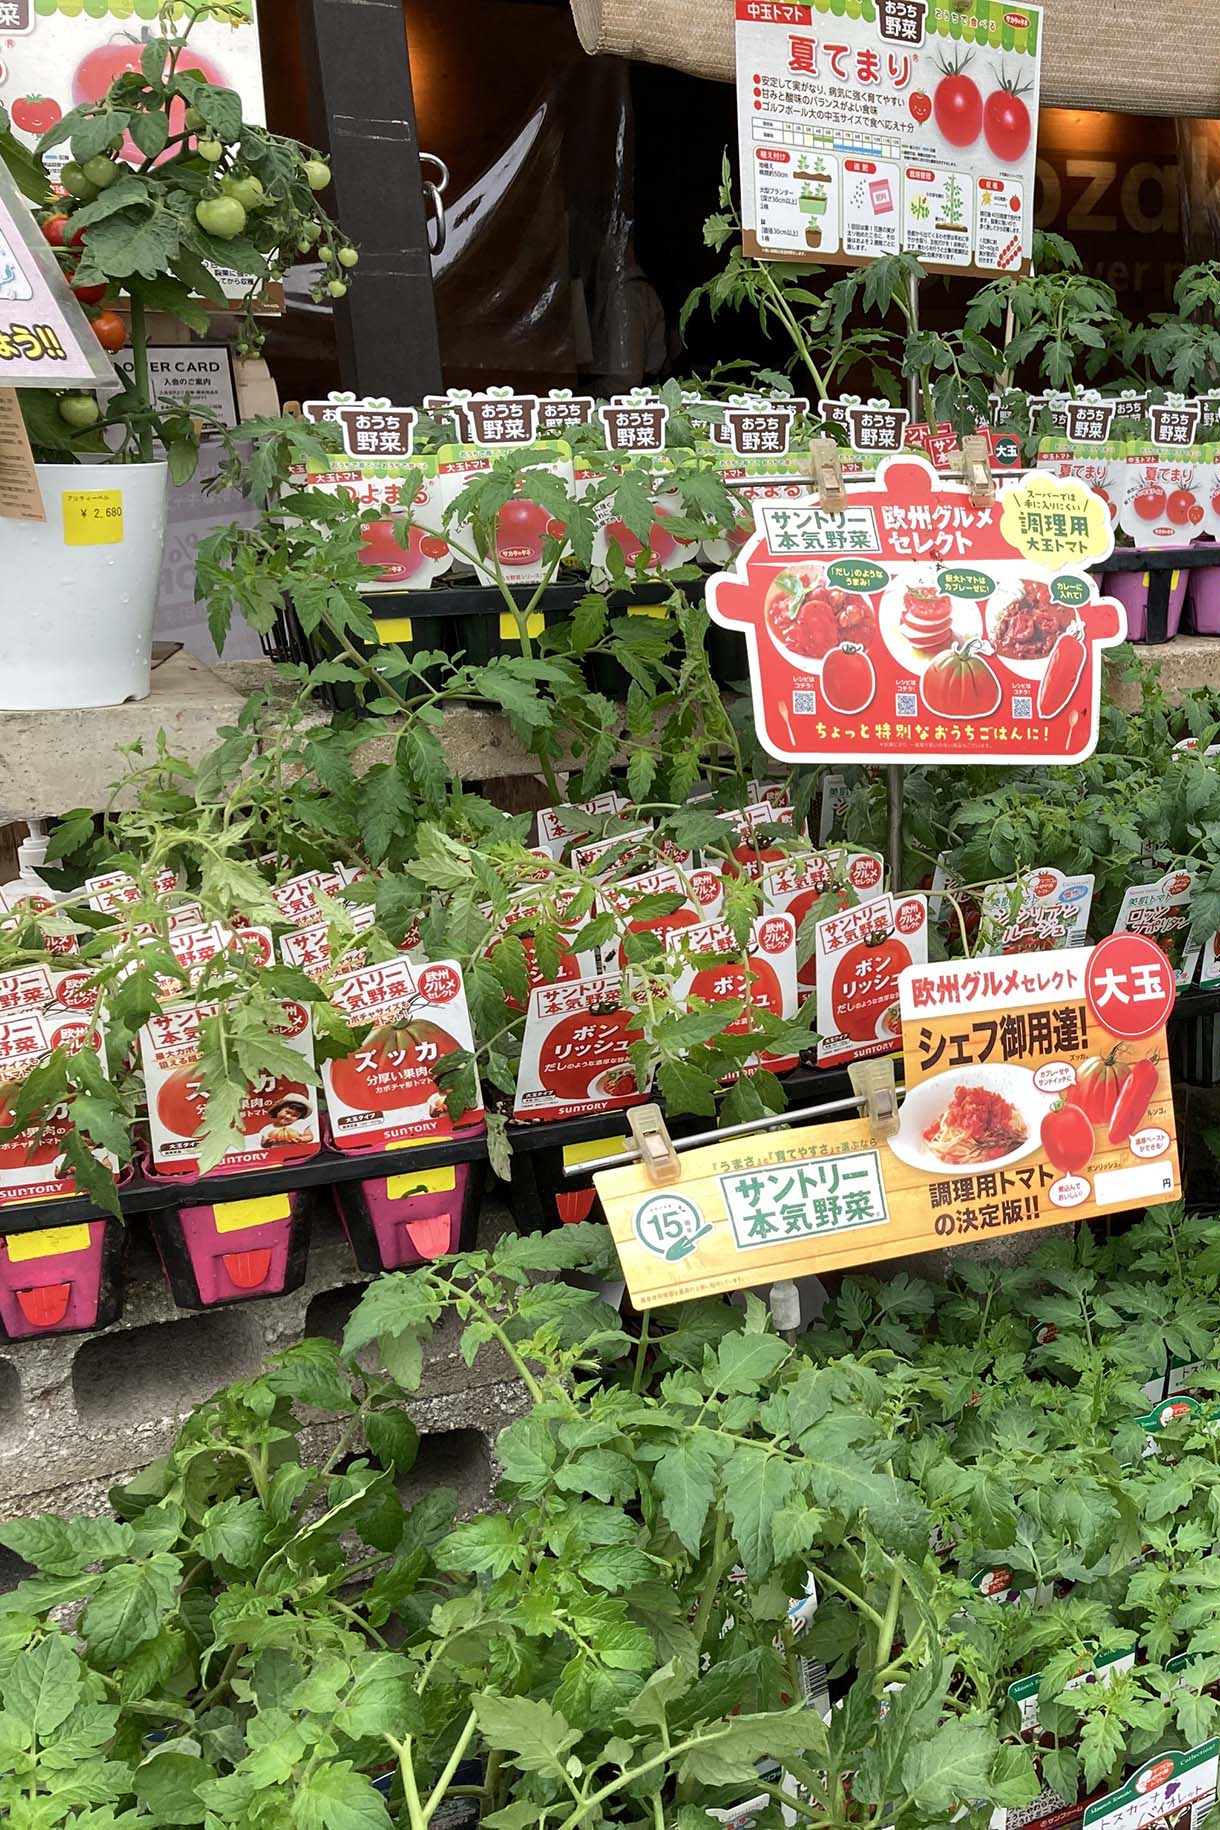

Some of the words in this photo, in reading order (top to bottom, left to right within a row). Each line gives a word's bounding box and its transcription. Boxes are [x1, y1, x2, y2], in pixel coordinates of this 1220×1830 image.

[747, 2, 803, 22] 中玉トマト
[885, 1, 918, 18] おうち
[885, 16, 918, 40] 野菜
[761, 75, 905, 107] 安定して実がなり、病気に強く育てやすい
[762, 89, 877, 115] 甘みと酸味のバランスがよい食味
[762, 102, 914, 133] ゴルフボール大の中玉サイズで食べ応え十分
[175, 362, 220, 372] CARD
[164, 378, 211, 386] 入会のご案内
[481, 403, 523, 417] おうち
[544, 403, 581, 417] おうち
[1077, 409, 1104, 421] おうち
[356, 415, 400, 430] おうち
[616, 413, 654, 425] おうち
[741, 418, 779, 430] おうち
[861, 414, 896, 427] おうち
[1160, 412, 1189, 425] おうち
[483, 419, 529, 440] 野菜
[617, 427, 659, 447] 野菜
[1075, 422, 1104, 439] 野菜
[1159, 426, 1190, 442] 野菜
[356, 431, 402, 452] 野菜
[742, 432, 783, 451] 野菜
[861, 429, 898, 448] 野菜
[996, 445, 1018, 457] 大玉
[445, 461, 488, 473] 大玉トマト
[1060, 464, 1105, 480] 夏てまり
[1145, 466, 1193, 482] 夏てまり
[316, 473, 358, 482] 大玉トマト
[1026, 490, 1076, 502] スーパーでは
[80, 508, 87, 518] ¥
[94, 506, 122, 519] 2,680
[1024, 499, 1081, 512] 手に入りにくい
[771, 509, 867, 529] サントリー
[882, 506, 993, 529] 欧州グルメ
[1019, 513, 1090, 538] 調理用
[776, 530, 872, 550] 本気野菜
[887, 534, 972, 556] セレクト
[1026, 539, 1089, 554] 大玉トマト
[830, 566, 883, 579] 「だし」のような
[944, 574, 987, 584] 巨大トマトは
[845, 577, 871, 588] うまみ!
[944, 582, 990, 593] カプレーゼに!
[1056, 582, 1083, 592] カレーに
[1060, 590, 1082, 600] 入れて!
[815, 722, 1049, 741] ちょっと特別なおうちごはんに!
[854, 868, 881, 880] グルメ
[856, 861, 874, 871] 欧州
[854, 876, 877, 885] セレクト
[900, 904, 919, 917] 欧州
[824, 903, 888, 936] サントリー
[898, 912, 922, 926] グルメ
[765, 922, 785, 934] 欧州
[900, 922, 921, 934] セレクト
[763, 931, 790, 944] グルメ
[765, 941, 788, 951] セレクト
[855, 957, 891, 977] ボン
[424, 969, 449, 983] 欧州
[423, 977, 459, 995] グルメ
[544, 981, 619, 1001] サントリー
[912, 969, 1077, 1008] 欧州グルメセレクト
[1095, 964, 1165, 1008] 大玉
[427, 989, 457, 1001] セレクト
[574, 1024, 619, 1041] ボン
[918, 1006, 1088, 1070] シェフ御用達!
[354, 1042, 437, 1071] ズッカ
[555, 1039, 629, 1059] リッシュ
[854, 1041, 893, 1058] SUNTORY
[558, 1102, 608, 1115] SUNTORY
[384, 1122, 437, 1138] SUNTORY
[735, 1165, 869, 1207] サントリー
[929, 1164, 1054, 1208] 調理用トマト
[1163, 1178, 1171, 1189] 円
[743, 1191, 874, 1239] 本気野菜
[935, 1196, 1040, 1236] の決定版!!
[648, 1211, 683, 1240] 15
[1101, 1793, 1160, 1830] トスカーナ
[1138, 1786, 1203, 1825] バイオレット
